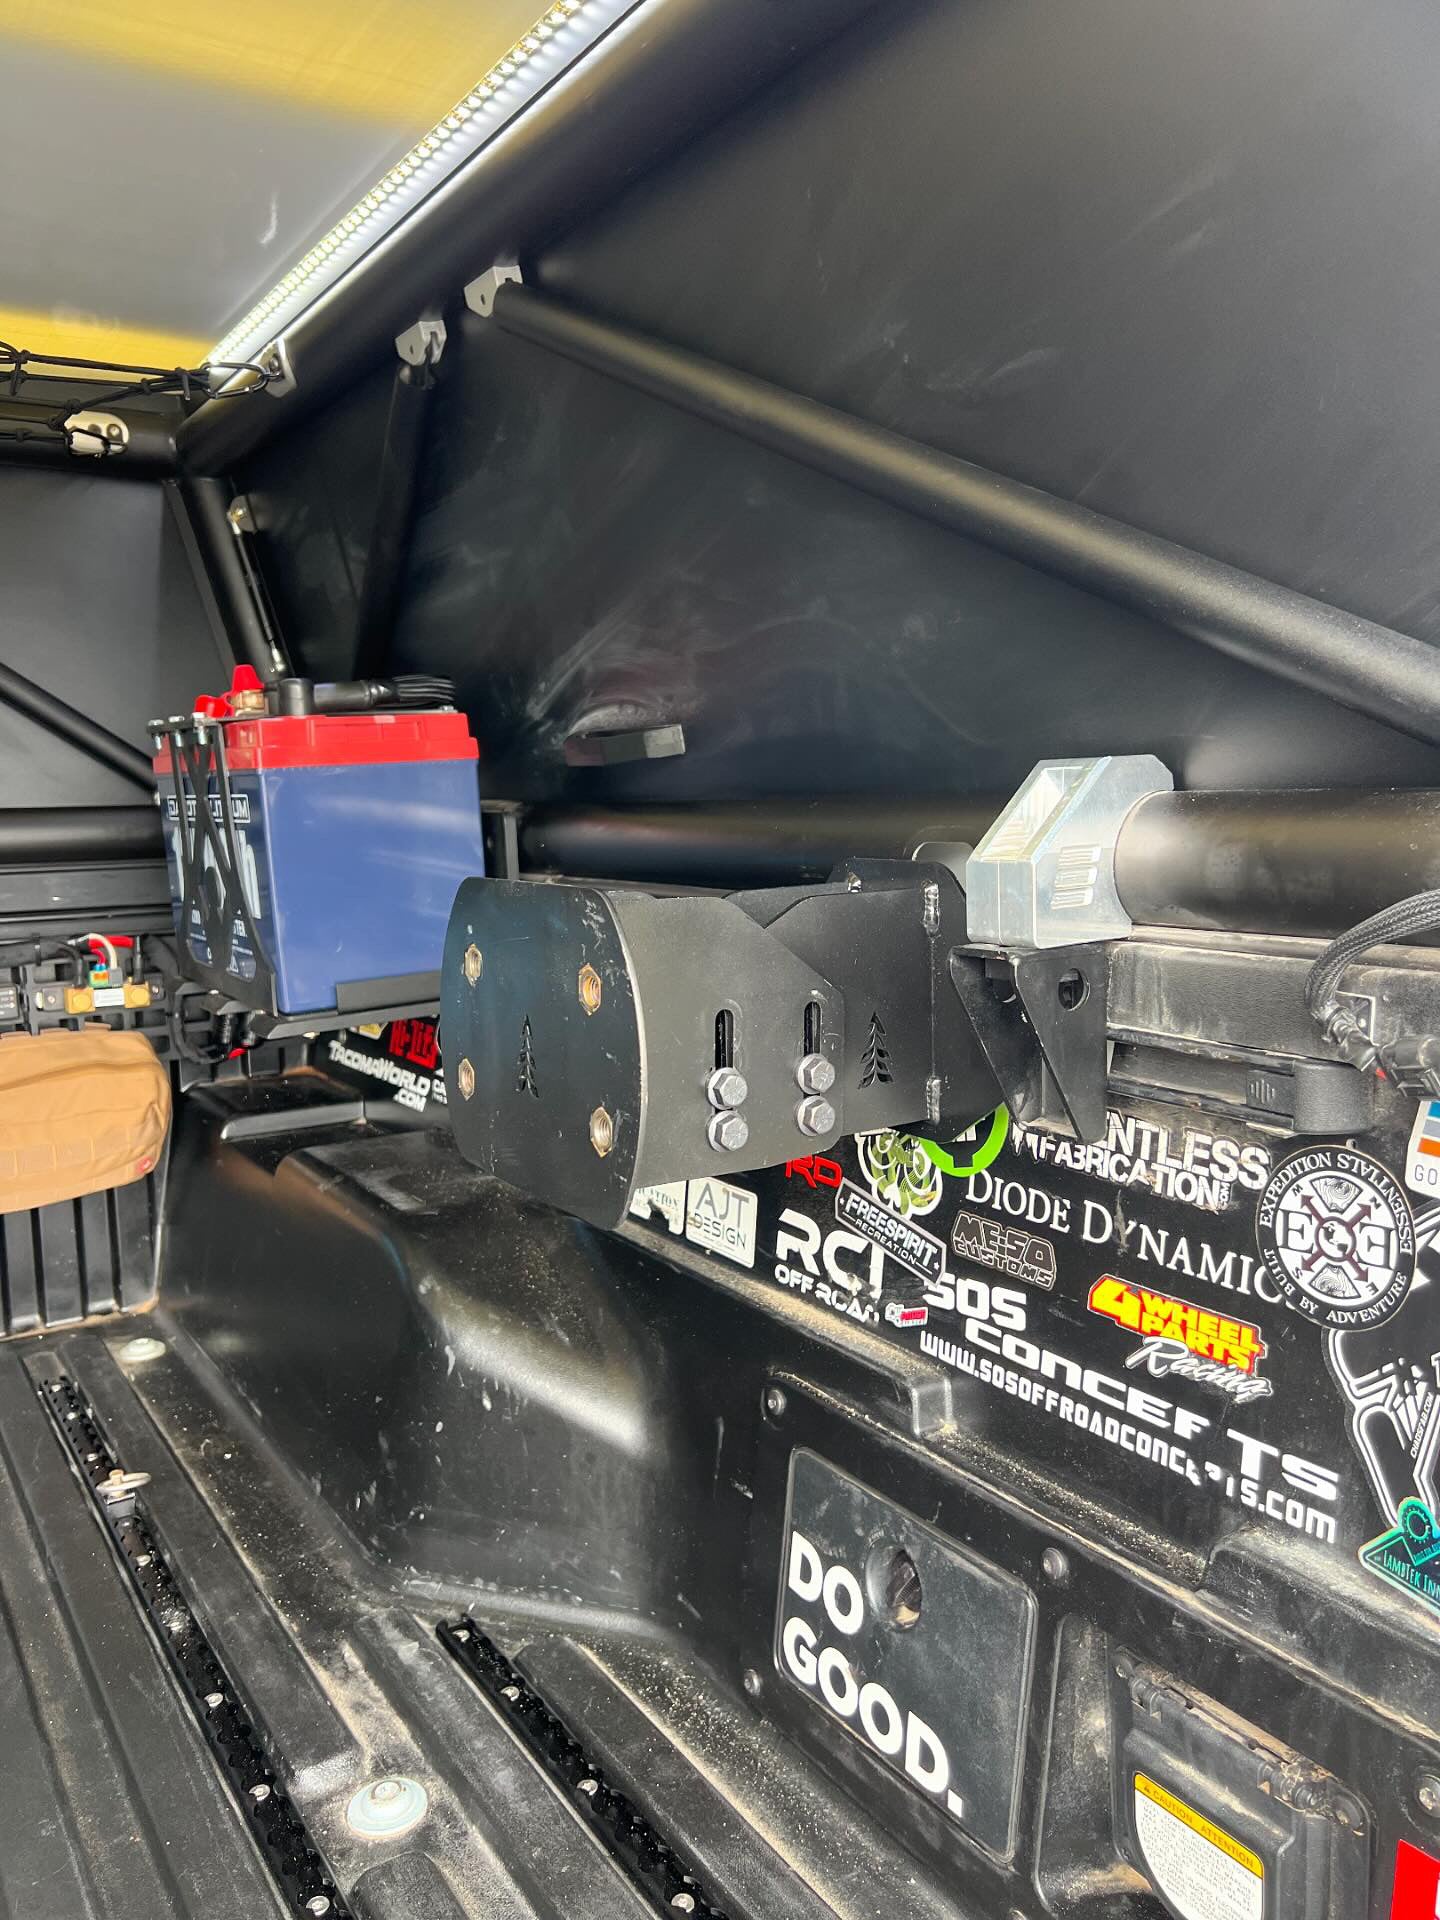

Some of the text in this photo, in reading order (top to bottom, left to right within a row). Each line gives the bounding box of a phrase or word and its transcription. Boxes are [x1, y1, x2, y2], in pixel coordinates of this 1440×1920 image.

[694, 1182, 750, 1230] AJT
[1260, 1152, 1332, 1229] EXPEDITION
[692, 1211, 747, 1250] DESIGN
[844, 1191, 938, 1267] FREESPIRIT
[855, 1217, 917, 1265] RECREATION
[965, 1168, 1290, 1308] DIODE DYNAMIC
[774, 1263, 815, 1294] OFF
[922, 1272, 1027, 1332] SOS
[1092, 1276, 1262, 1354] 4 WHEEL
[1263, 1248, 1407, 1324] BUILT BY ADVENTURE
[1125, 1336, 1272, 1404] Racing
[1141, 1311, 1251, 1370] PARTS
[787, 1530, 864, 1635] DO
[782, 1616, 963, 1819] GOOD.
[1153, 1789, 1254, 1868] CAUTION ATTENTION
